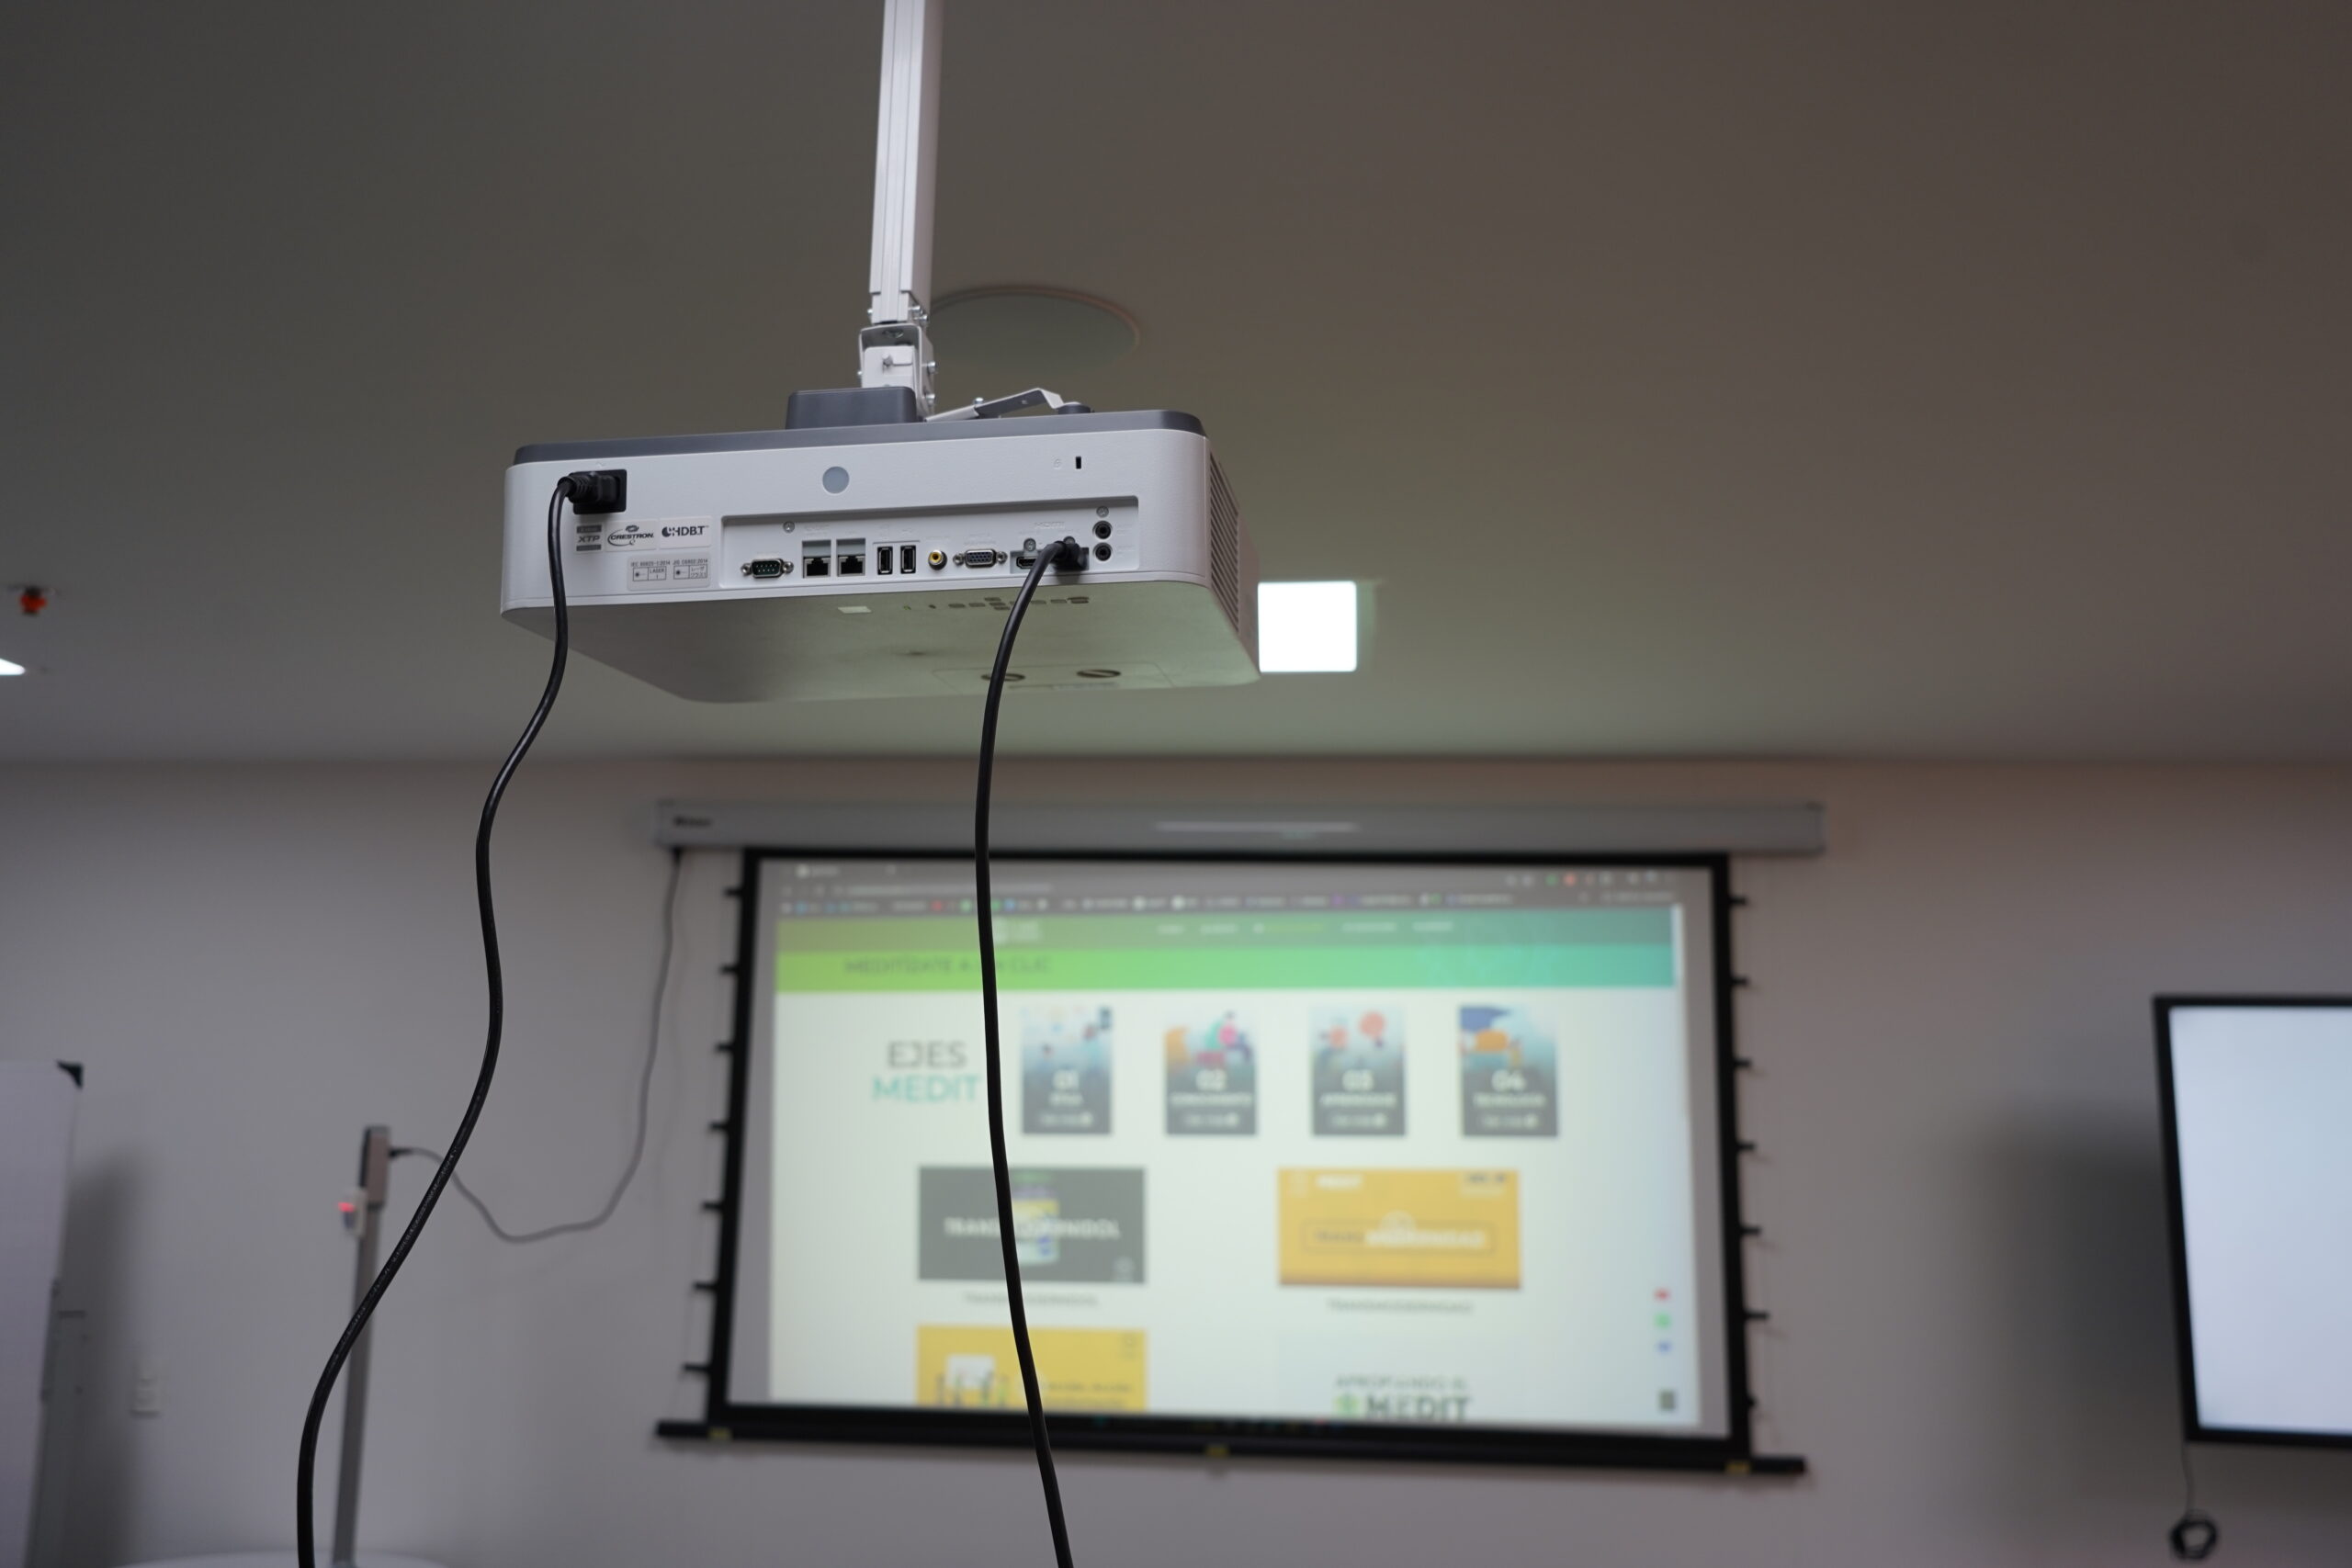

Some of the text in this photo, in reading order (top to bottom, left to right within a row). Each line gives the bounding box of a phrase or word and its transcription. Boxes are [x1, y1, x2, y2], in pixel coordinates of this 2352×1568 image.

[578, 535, 600, 543] XTP
[610, 533, 654, 541] CRESTRON
[888, 1041, 967, 1068] EJES
[872, 1075, 979, 1101] MEDIT
